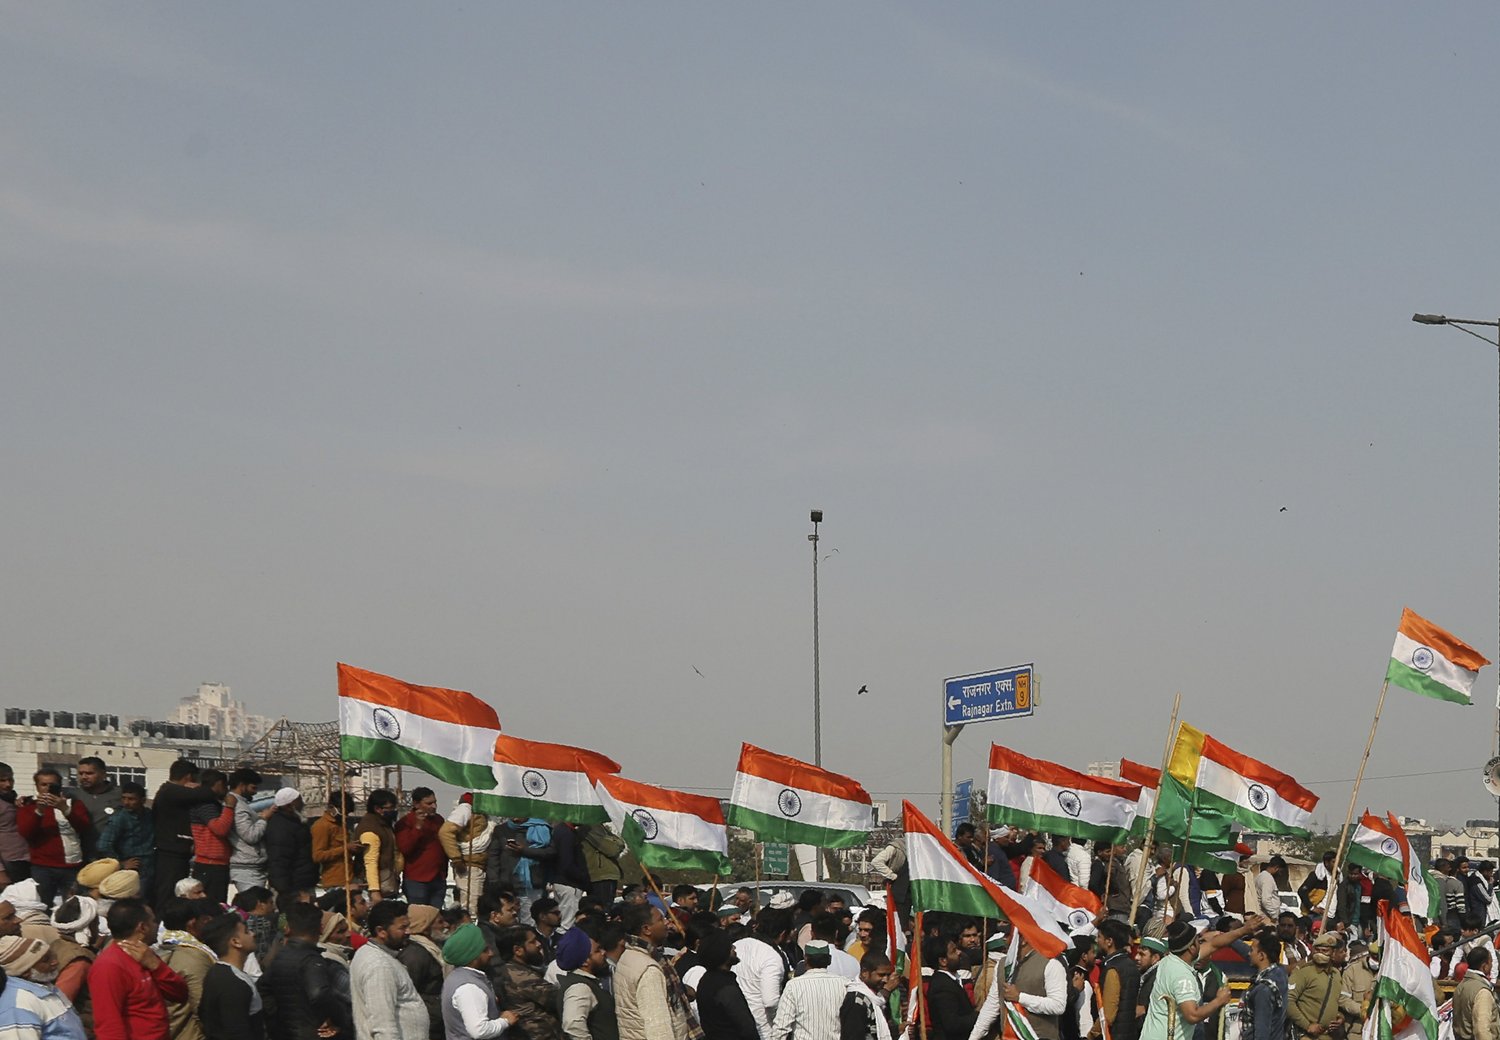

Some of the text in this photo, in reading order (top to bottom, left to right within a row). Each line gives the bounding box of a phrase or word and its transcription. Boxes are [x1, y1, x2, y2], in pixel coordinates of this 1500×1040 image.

[962, 683, 992, 698] राजनगर
[962, 699, 1015, 718] Rajnagar Extn.
